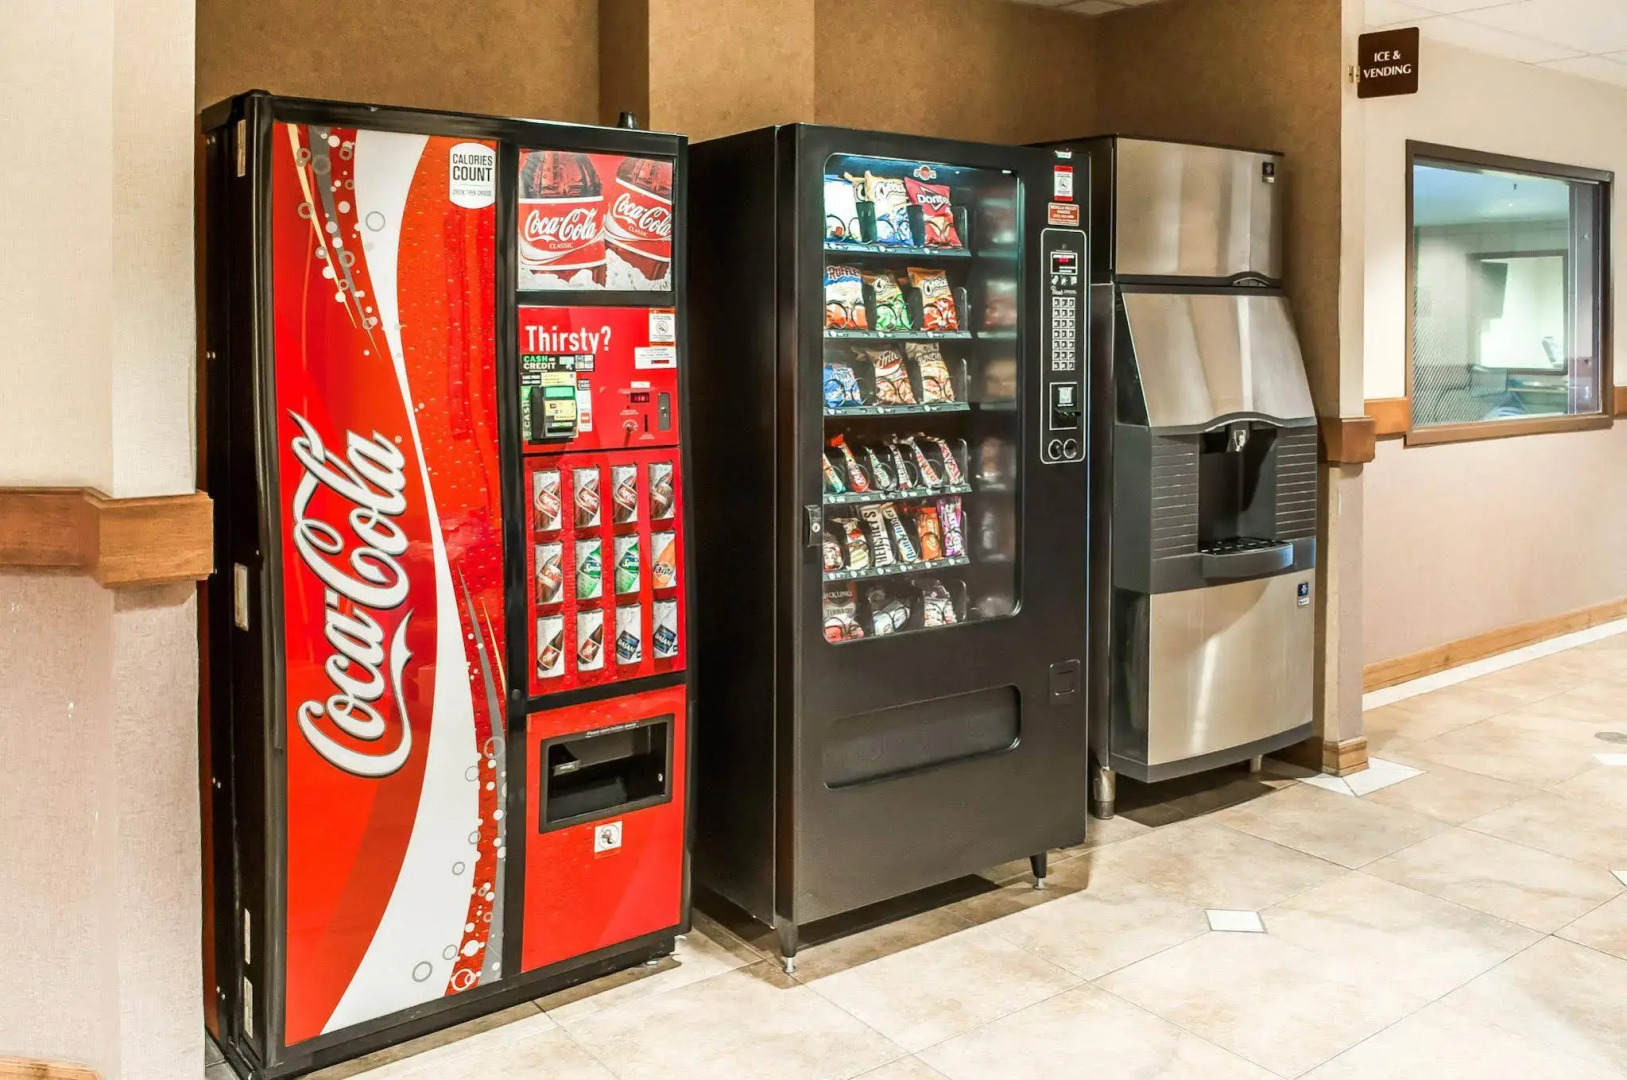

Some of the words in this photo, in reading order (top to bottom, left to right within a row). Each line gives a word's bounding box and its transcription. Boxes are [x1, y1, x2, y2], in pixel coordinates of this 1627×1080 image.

[1374, 51, 1390, 62] ICE
[1392, 50, 1401, 60] &
[1363, 63, 1412, 79] VENDING
[452, 153, 493, 166] CALORIES
[452, 165, 493, 182] COUNT
[524, 207, 598, 243] Coca-Cola
[628, 225, 649, 238] CLASSIC
[525, 325, 612, 354] Thirsty?
[523, 355, 548, 363] CASH
[523, 362, 556, 370] CREDIT
[523, 401, 531, 429] CASH
[863, 510, 888, 564] HERSHEY'S
[884, 508, 918, 560] Butterfinger
[286, 408, 414, 779] Coca-Cola
